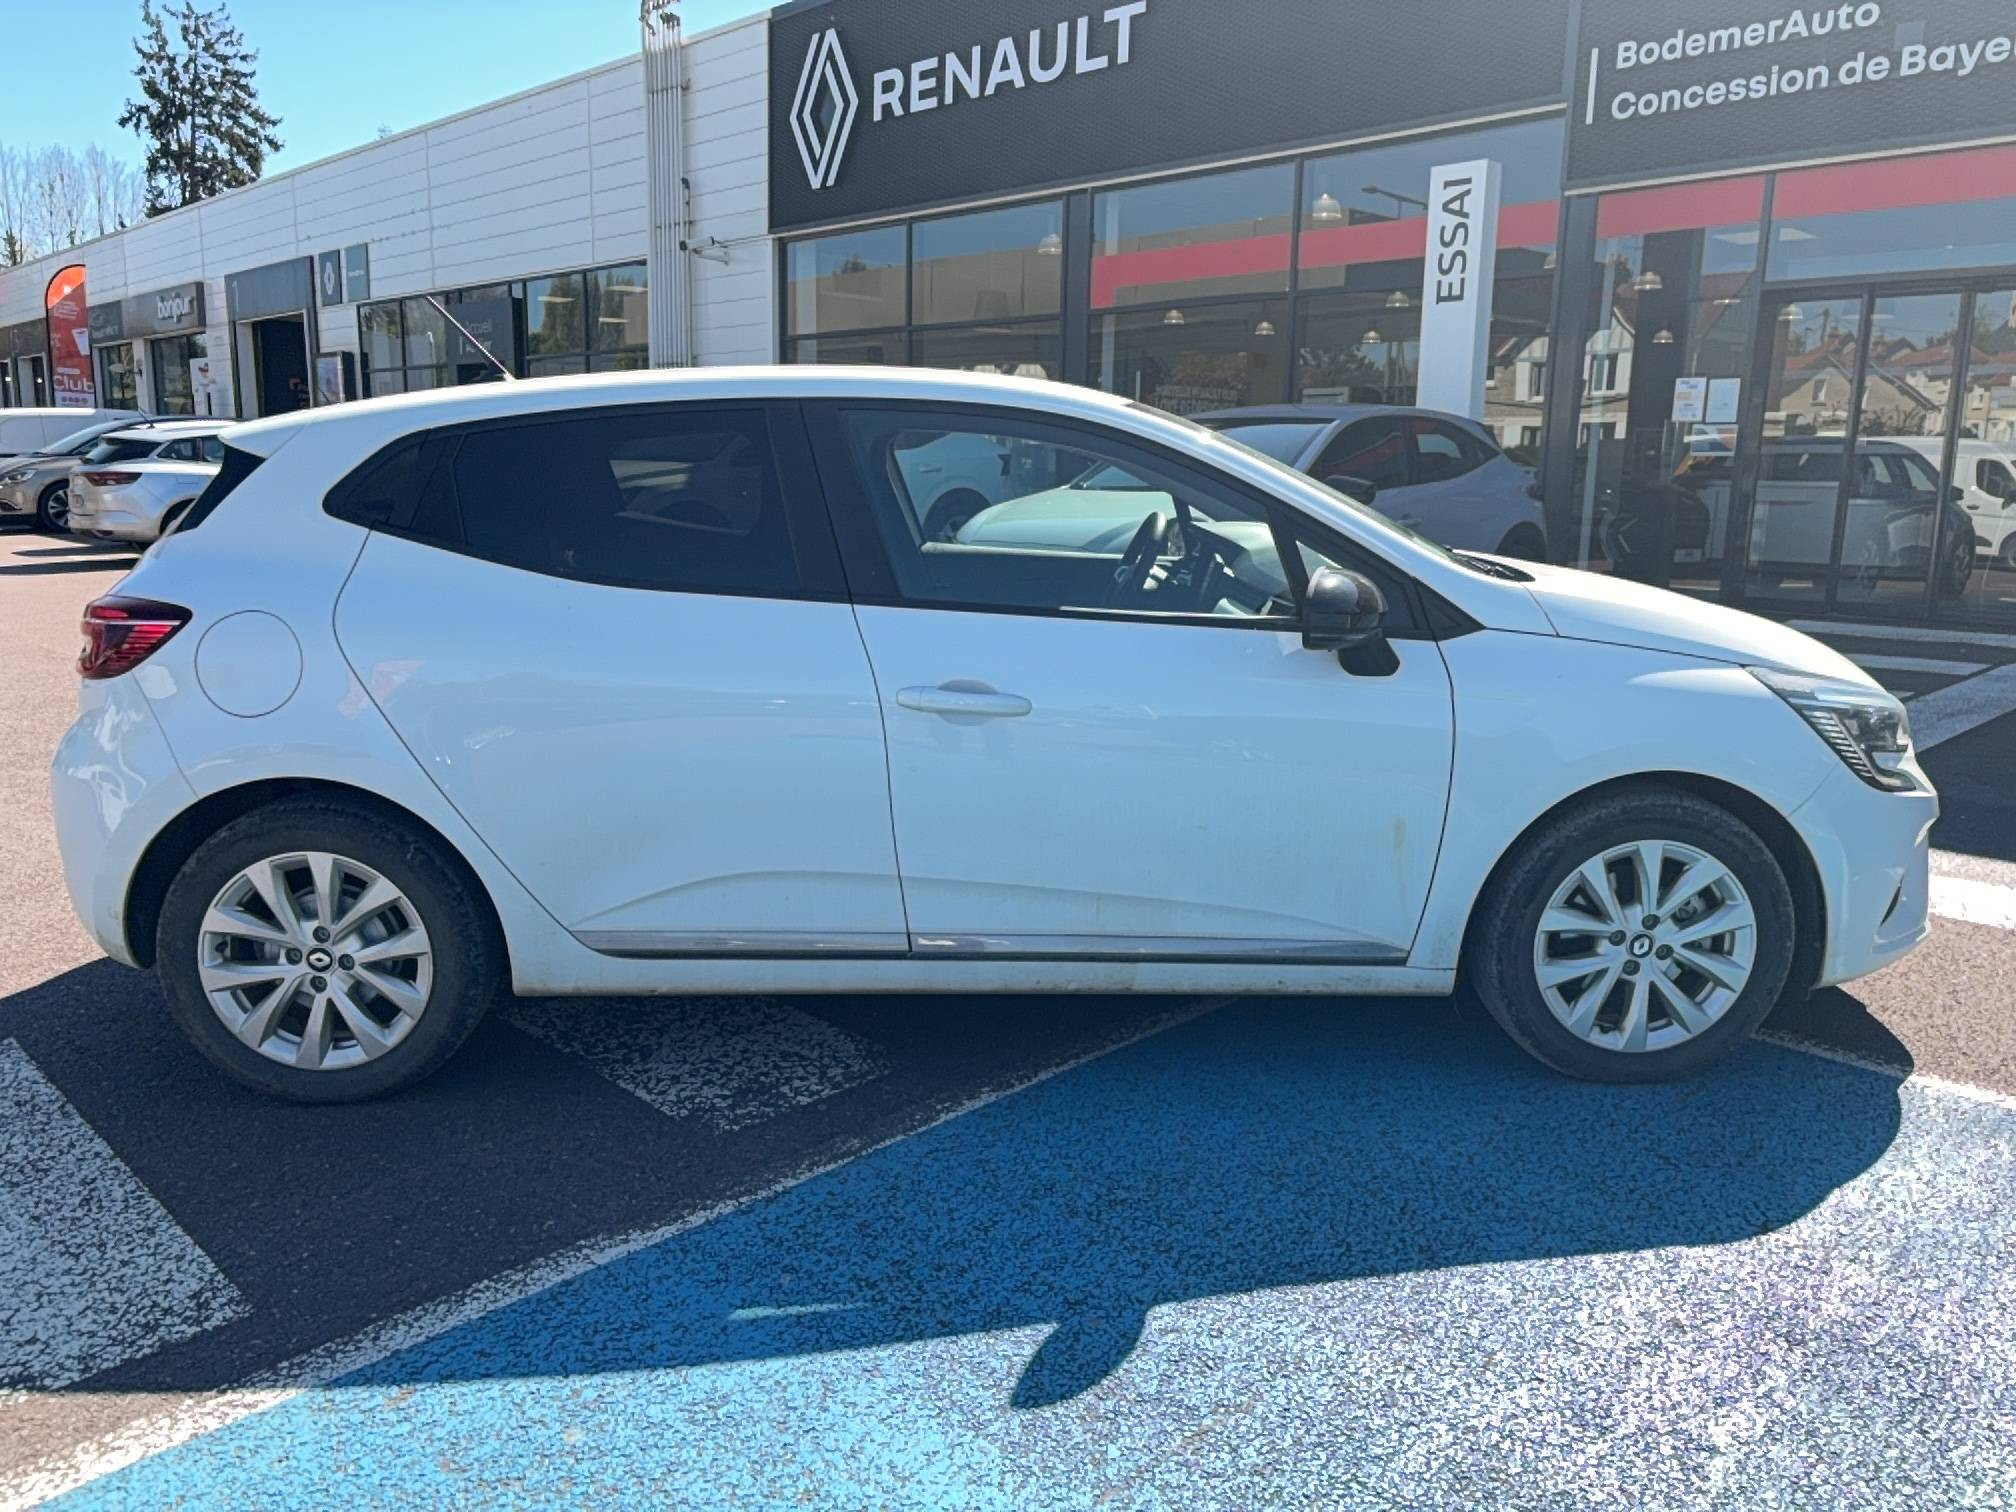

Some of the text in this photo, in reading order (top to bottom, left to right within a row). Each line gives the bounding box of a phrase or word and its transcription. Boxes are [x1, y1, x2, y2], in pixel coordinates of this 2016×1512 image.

[873, 0, 1147, 122] RENAULT
[1615, 2, 1880, 69] BodemerAuto
[1611, 36, 2016, 120] Concession de Baye
[1435, 176, 1473, 305] ESSAI
[53, 375, 95, 392] Club
